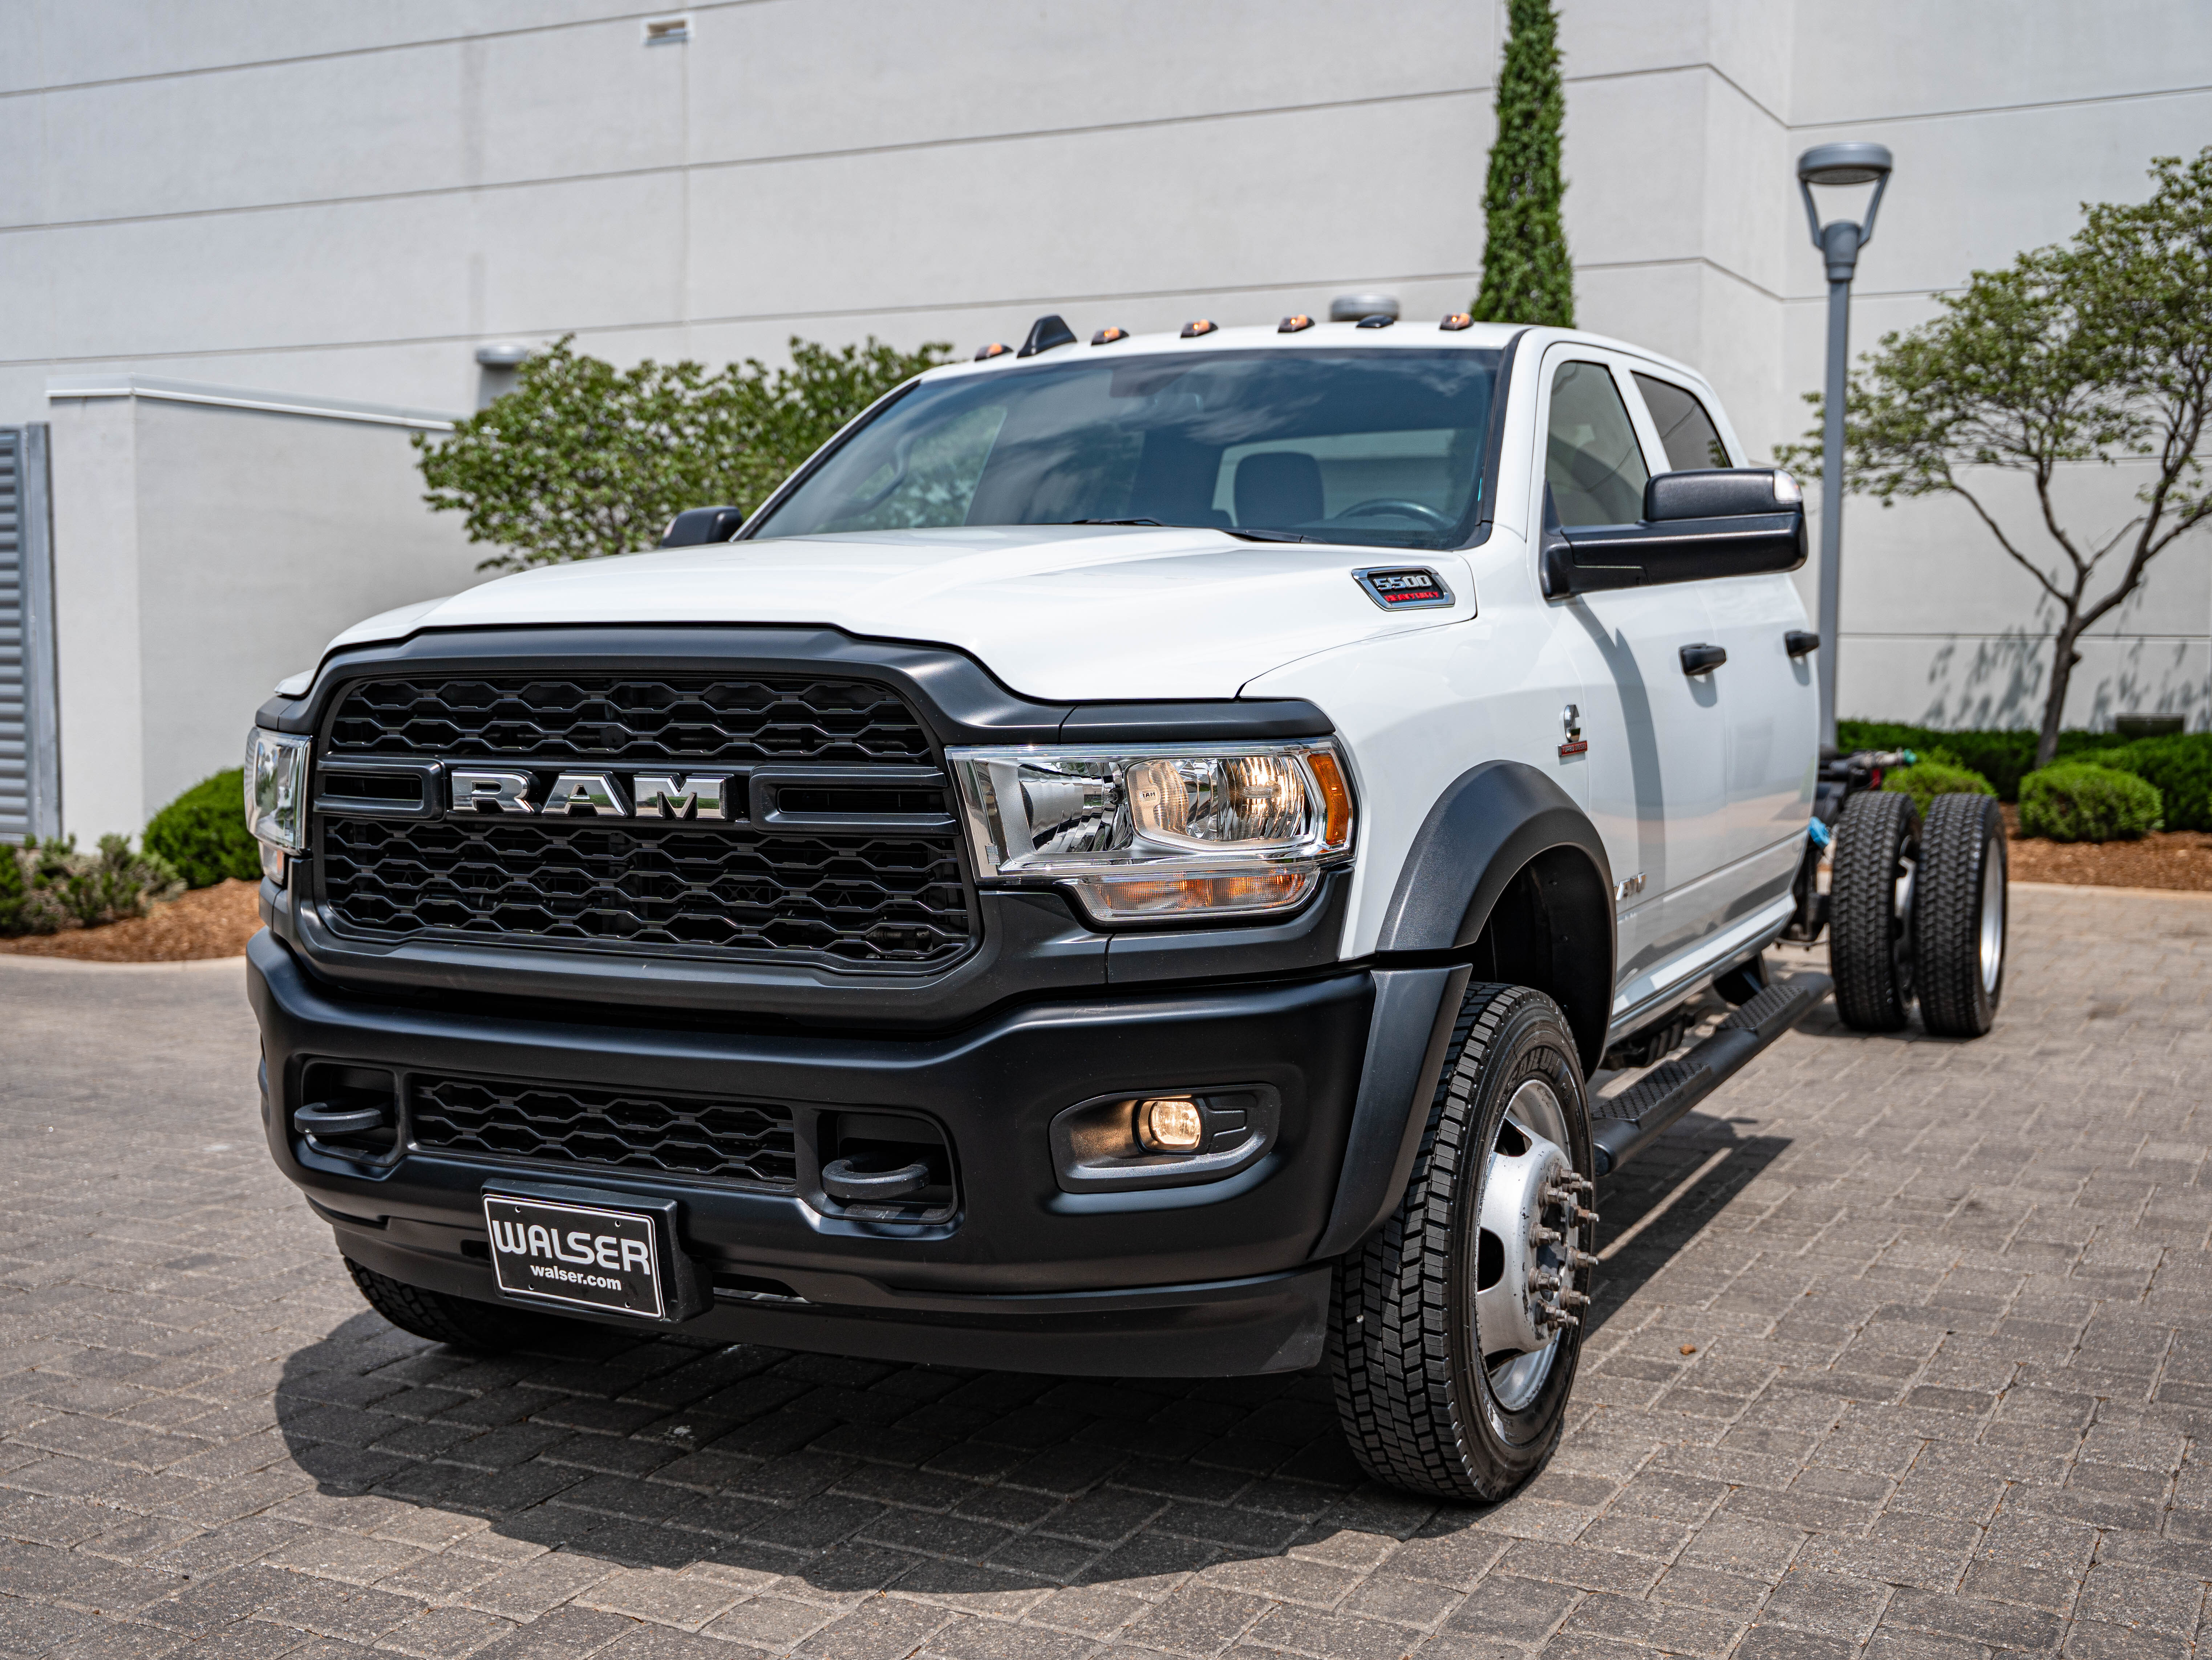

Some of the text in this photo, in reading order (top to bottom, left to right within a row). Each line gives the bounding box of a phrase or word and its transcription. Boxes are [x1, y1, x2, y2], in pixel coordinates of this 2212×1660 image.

[1373, 575, 1432, 591] 5500
[1384, 591, 1439, 602] HEAVY DUTY
[451, 767, 734, 820] RAM
[492, 1220, 651, 1275] WALSER
[530, 1265, 622, 1291] walser.com
